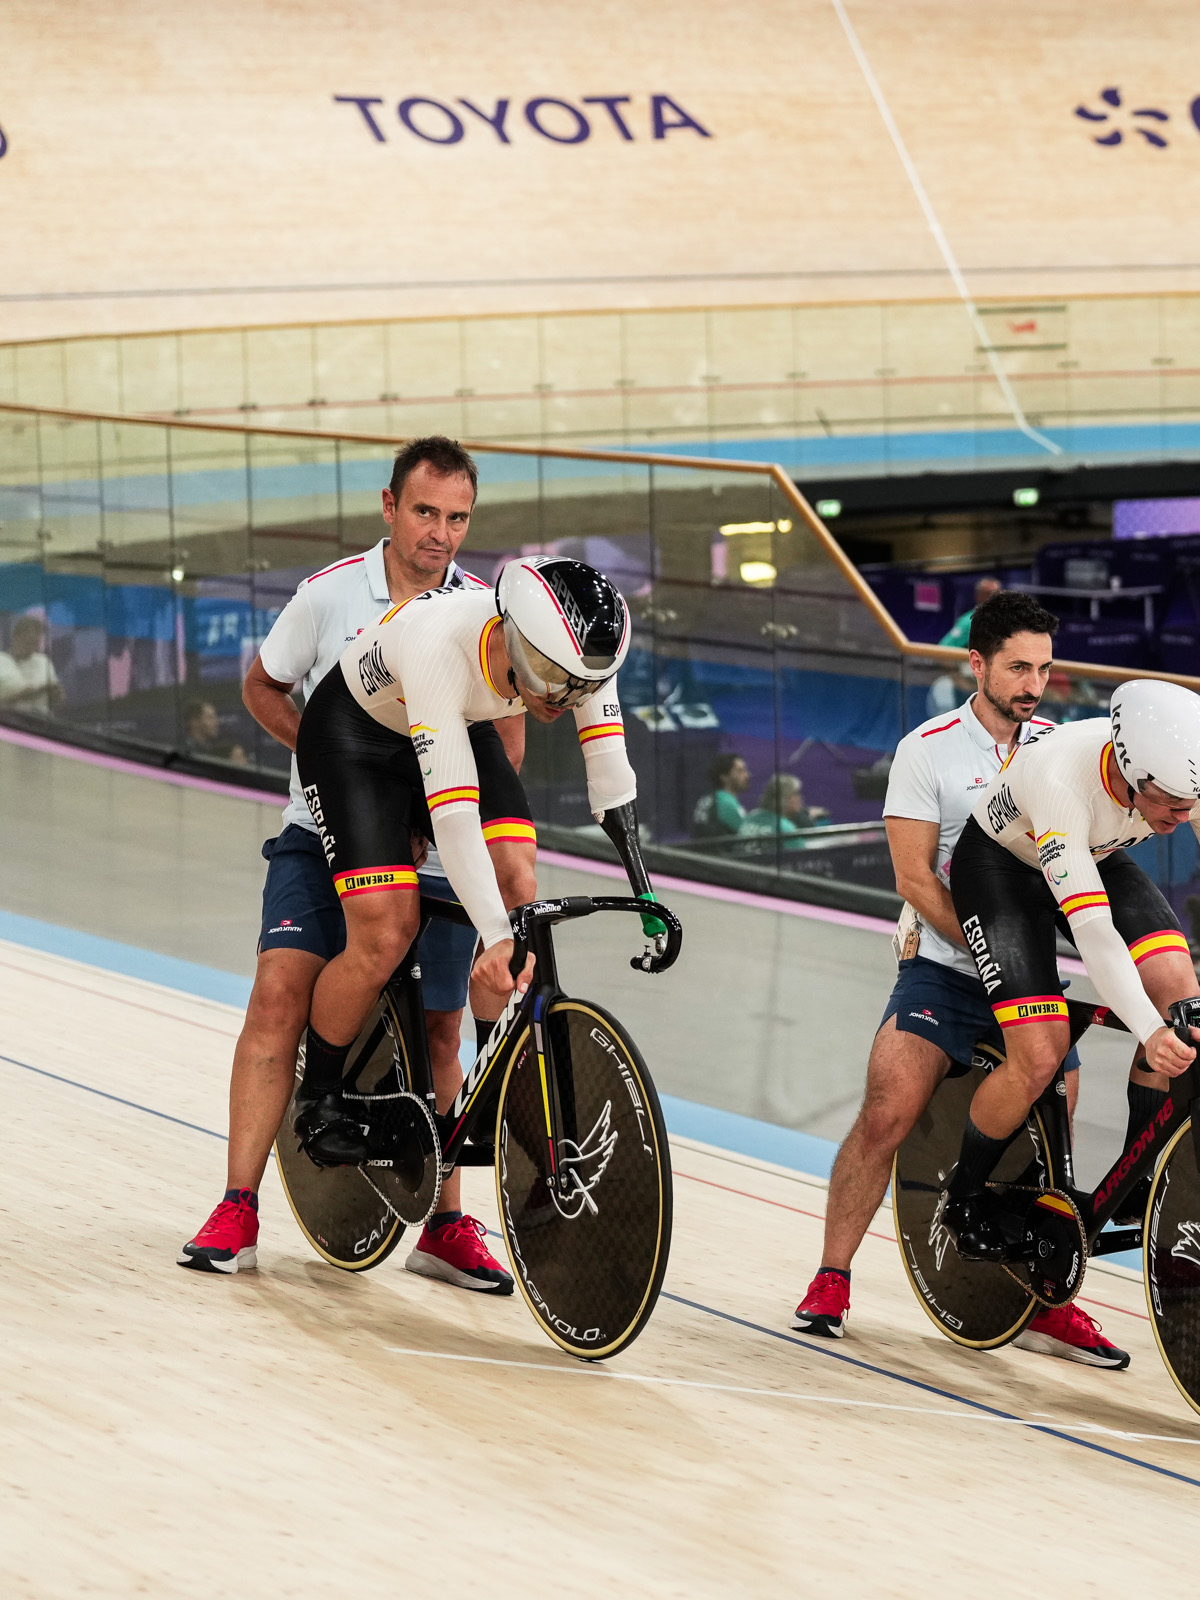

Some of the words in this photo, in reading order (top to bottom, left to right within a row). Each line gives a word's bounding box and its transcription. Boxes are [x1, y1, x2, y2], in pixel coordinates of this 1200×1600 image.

[332, 94, 713, 146] TOYOTA
[550, 569, 588, 648] SPEED
[1111, 703, 1132, 771] KASK
[302, 783, 337, 869] ESPAÑA
[986, 782, 1022, 835] ESPAÑA
[961, 914, 1003, 996] ESPAÑA
[589, 1027, 654, 1156] GHIBLI
[1092, 1120, 1156, 1215] ARGON
[1154, 1096, 1175, 1129] 18
